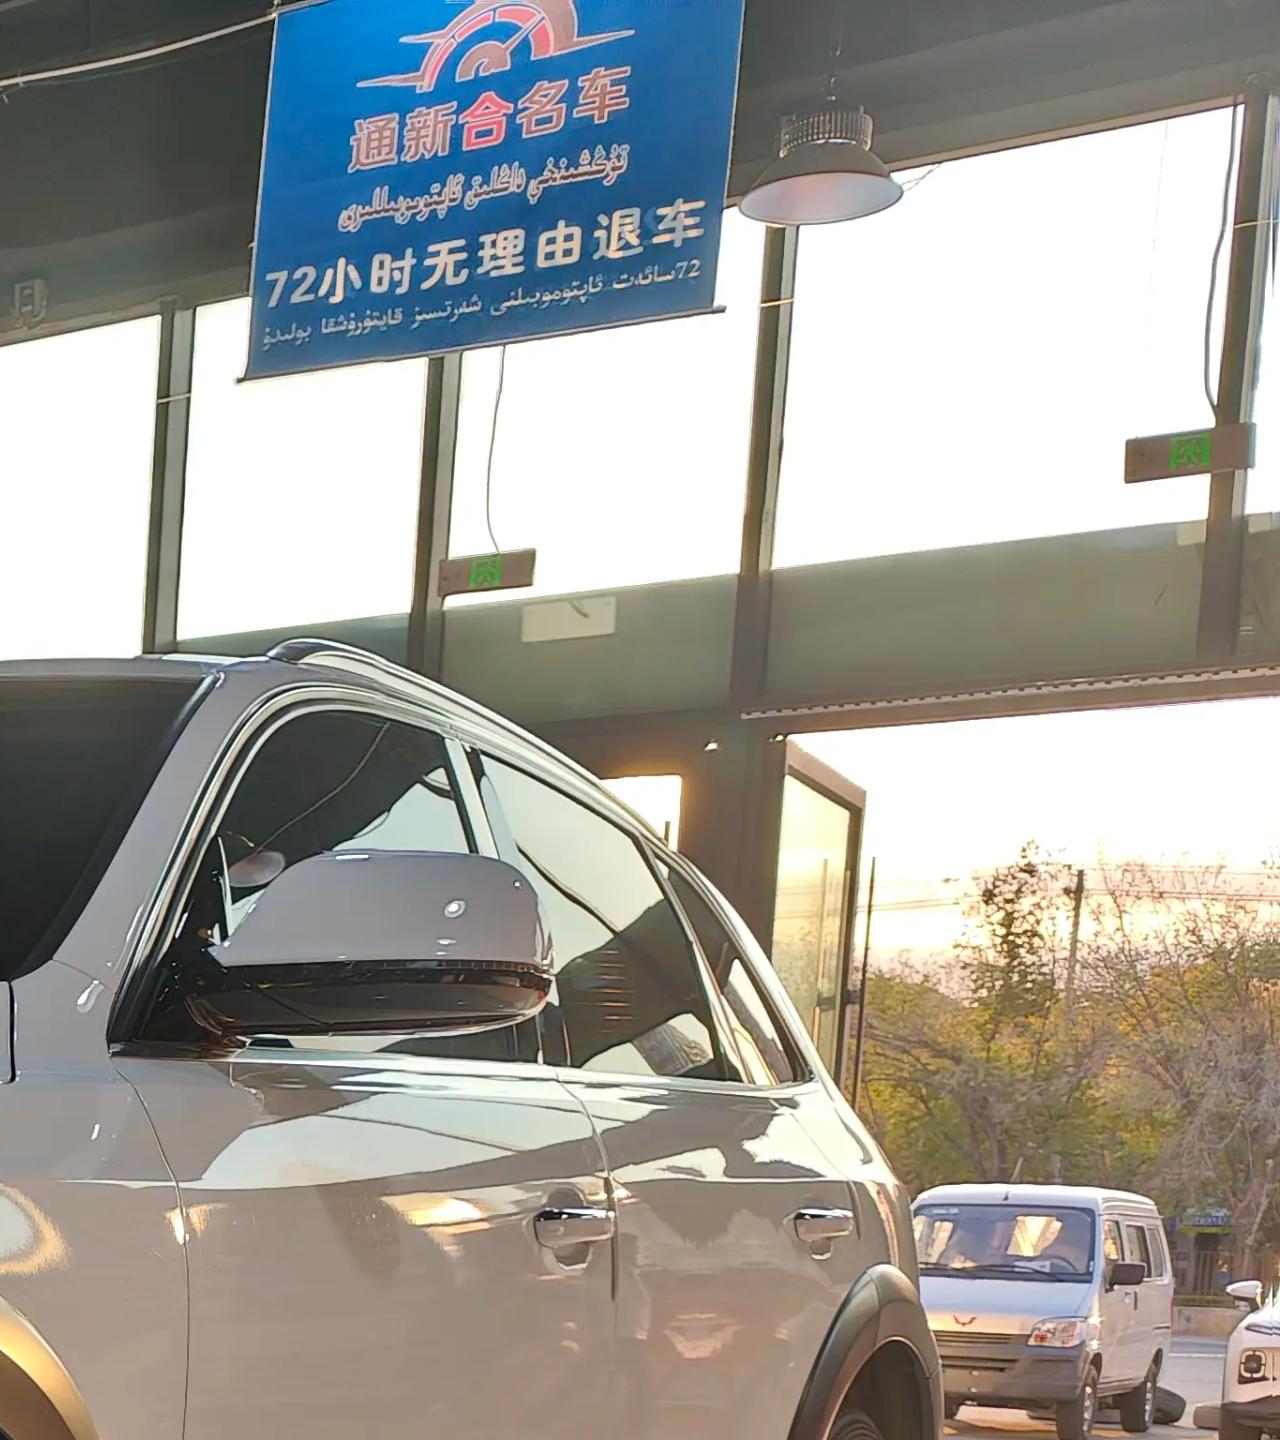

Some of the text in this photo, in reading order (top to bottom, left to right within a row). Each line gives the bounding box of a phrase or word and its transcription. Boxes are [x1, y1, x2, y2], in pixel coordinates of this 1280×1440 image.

[348, 64, 633, 174] 通新合名车
[264, 199, 706, 310] 72小时无理由退车
